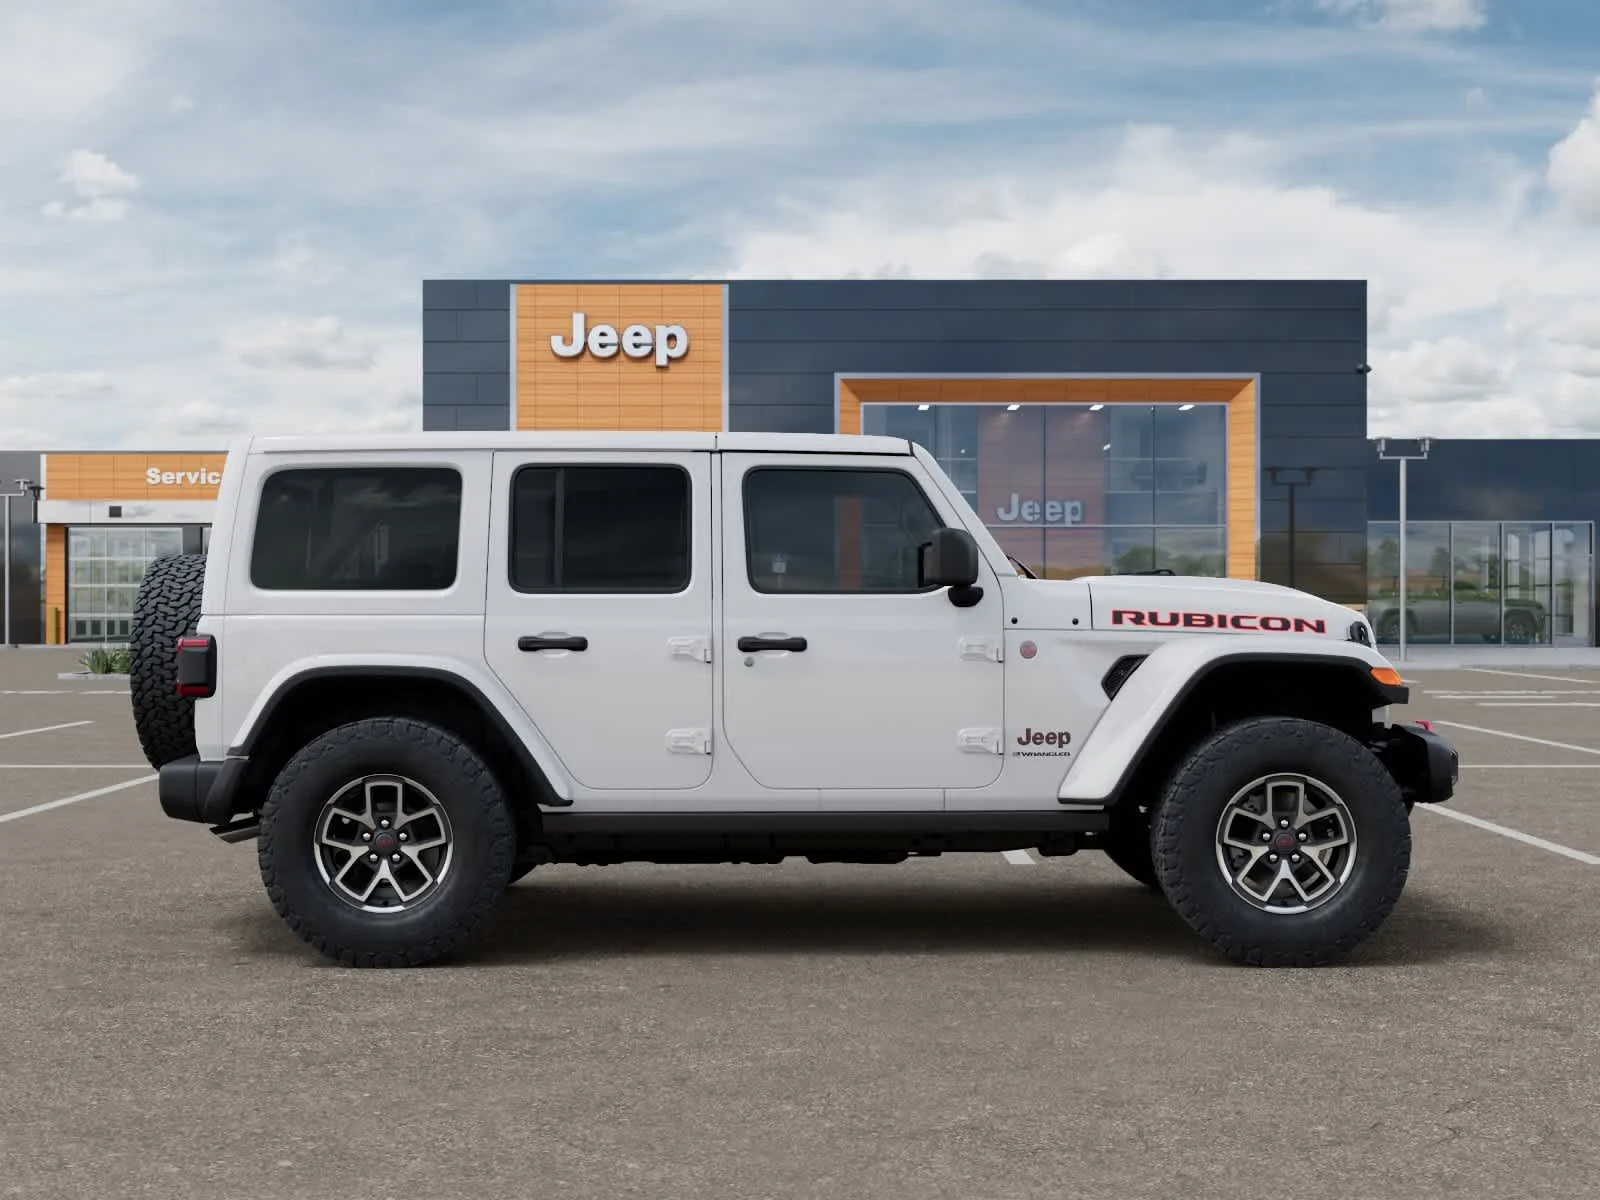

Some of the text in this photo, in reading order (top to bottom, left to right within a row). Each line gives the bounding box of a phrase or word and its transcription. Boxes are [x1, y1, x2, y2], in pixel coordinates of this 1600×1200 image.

[550, 312, 689, 367] Jeep
[146, 467, 221, 485] Servic
[996, 492, 1083, 526] Jeep
[1112, 609, 1326, 633] RUBICON
[1017, 727, 1071, 748] Jeep
